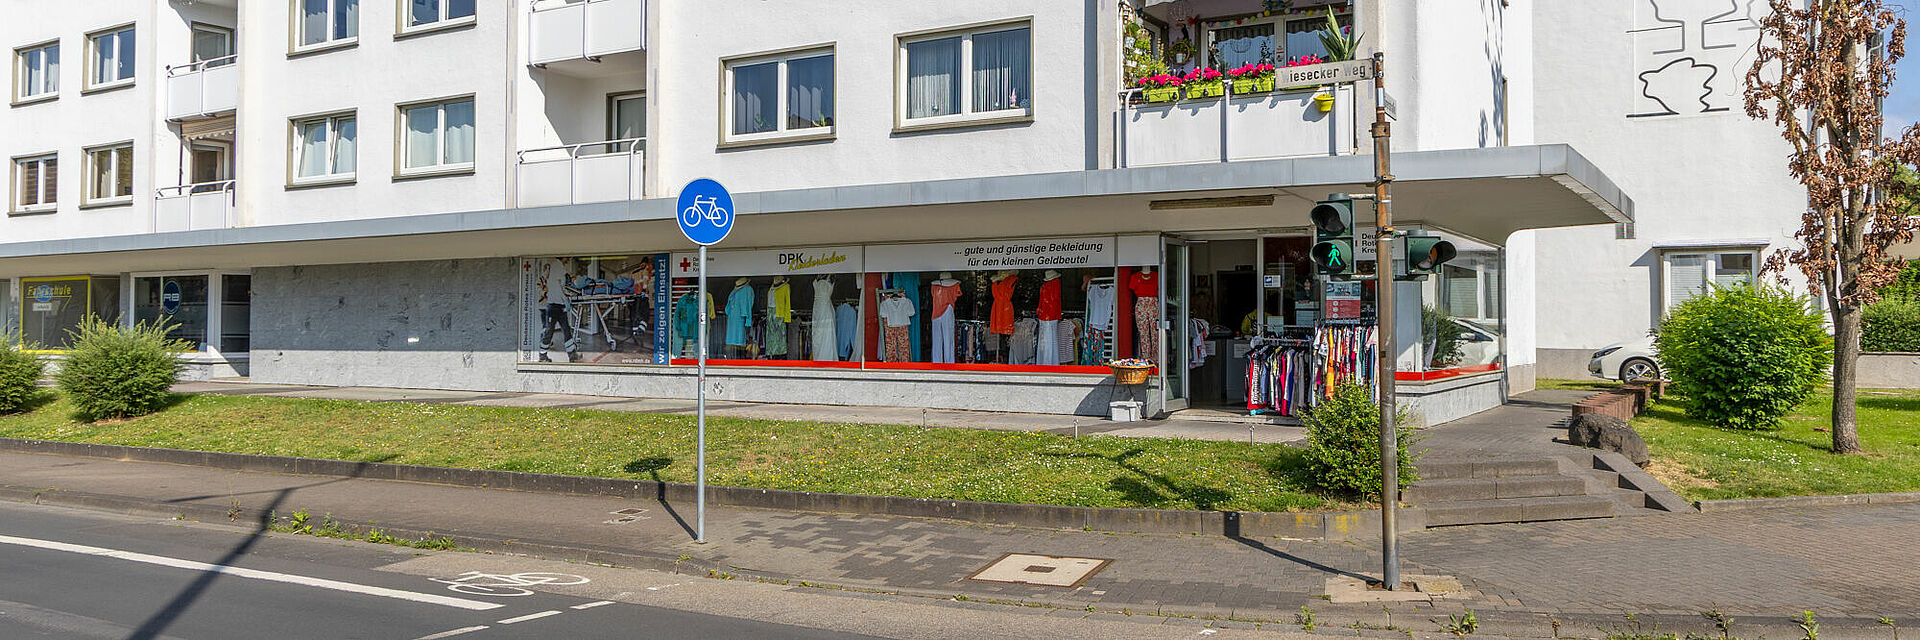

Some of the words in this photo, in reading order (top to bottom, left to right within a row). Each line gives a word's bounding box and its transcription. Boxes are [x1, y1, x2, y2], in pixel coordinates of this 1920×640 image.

[1343, 63, 1366, 78] Weg
[964, 246, 984, 256] gute
[987, 245, 1004, 254] und
[1006, 243, 1046, 255] günstige
[1049, 242, 1103, 253] Bekleidung
[788, 251, 846, 271] Kleiderladen
[967, 257, 980, 266] für
[982, 257, 999, 266] den
[1002, 257, 1034, 266] kleinen
[1037, 255, 1089, 265] Geldbeutel
[658, 259, 666, 303] Einsatz!
[658, 306, 667, 343] zeigen
